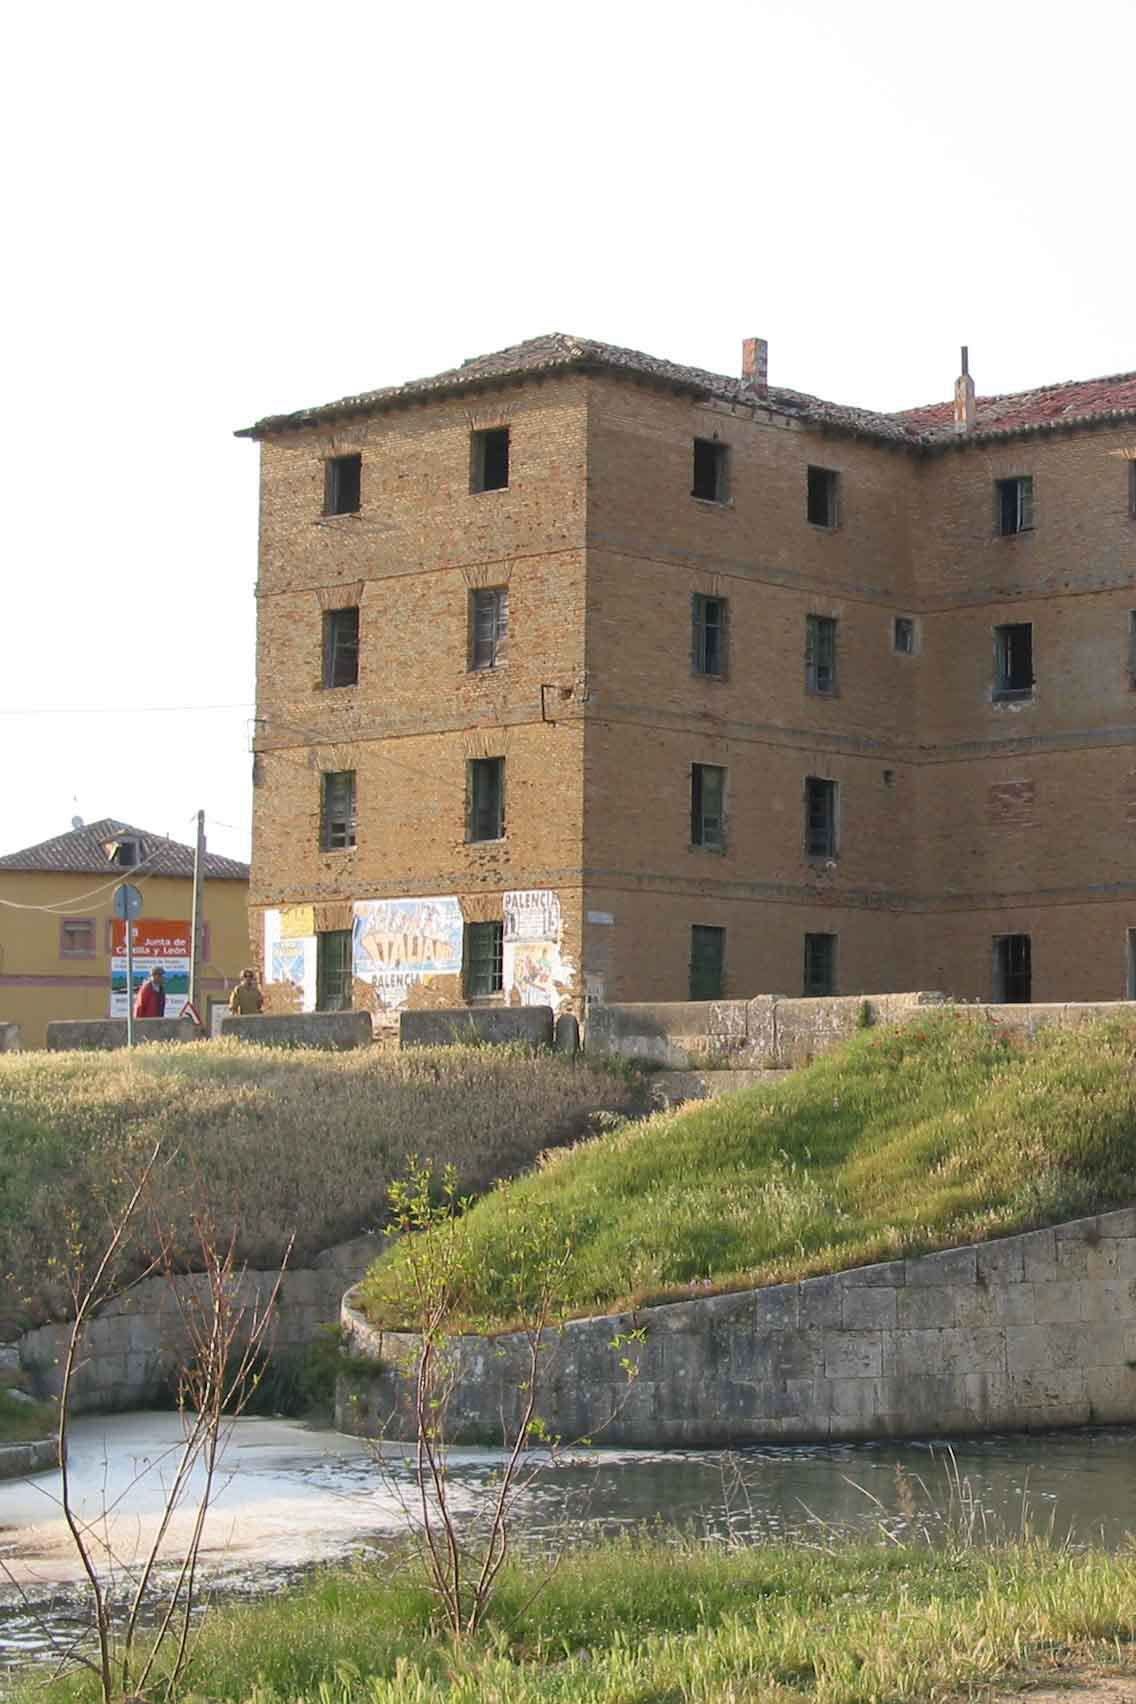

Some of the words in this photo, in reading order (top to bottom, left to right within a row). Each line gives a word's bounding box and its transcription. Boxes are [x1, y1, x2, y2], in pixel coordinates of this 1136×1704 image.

[505, 890, 560, 909] PALENCIA
[145, 938, 170, 946] Junta
[174, 938, 186, 946] de
[153, 948, 160, 956] y
[163, 946, 186, 954] León
